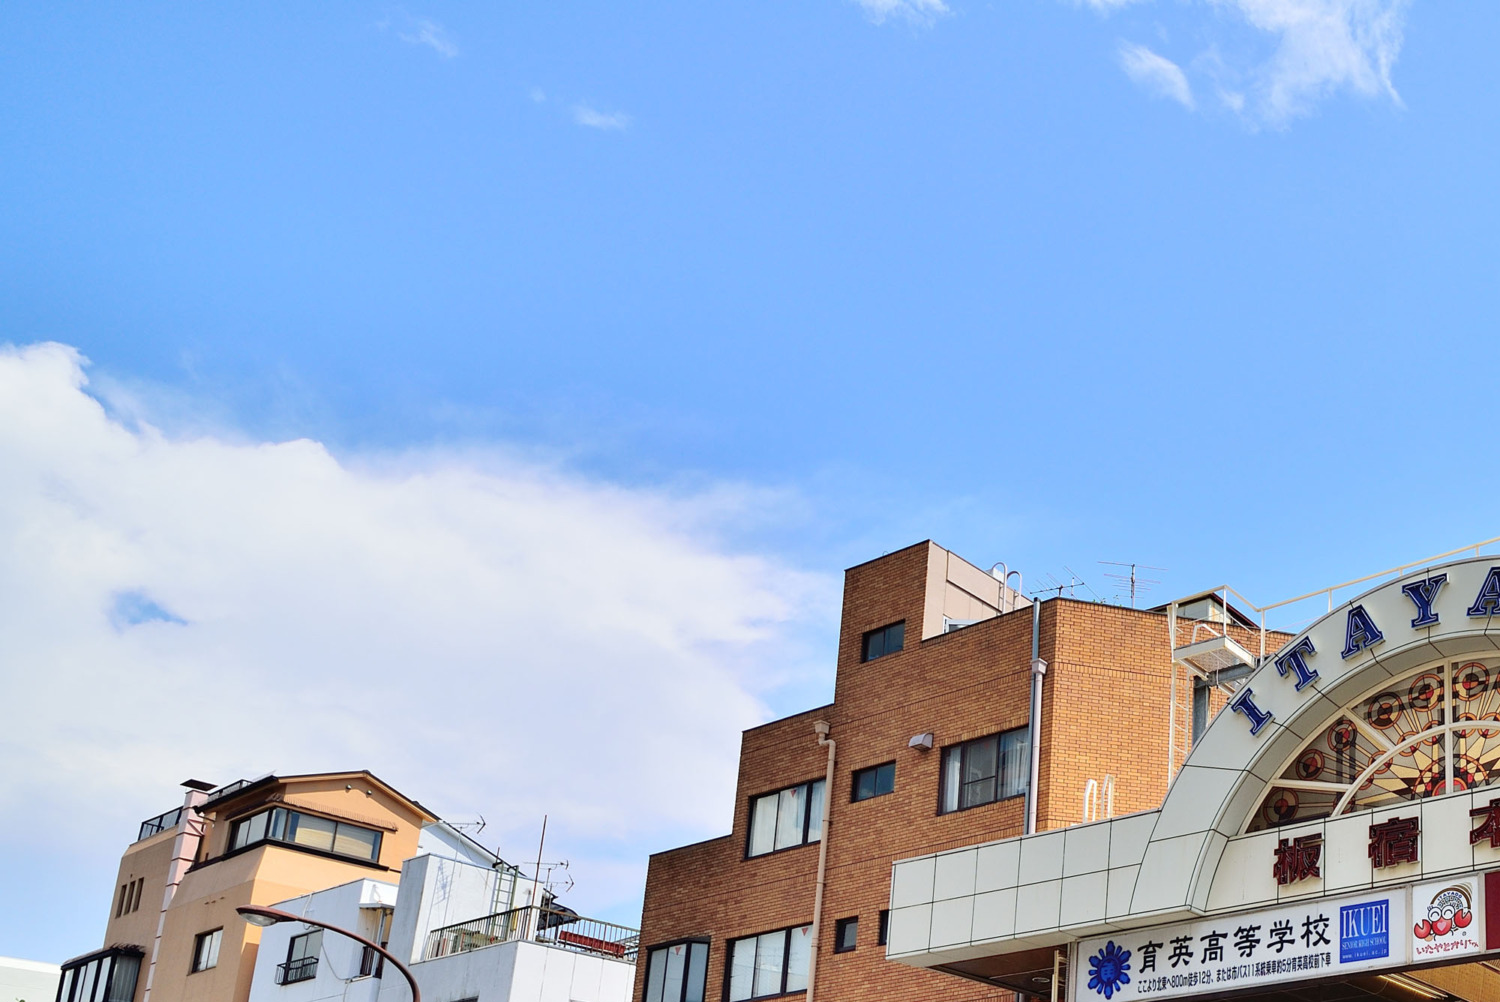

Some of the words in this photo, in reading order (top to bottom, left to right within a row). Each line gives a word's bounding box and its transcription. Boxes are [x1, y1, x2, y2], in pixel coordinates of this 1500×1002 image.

[1437, 890, 1463, 902] ITAYADO
[1342, 904, 1388, 939] IKUEI
[1137, 913, 1332, 974] 育英高等学校
[1416, 939, 1479, 955] いたやどかりちゃん
